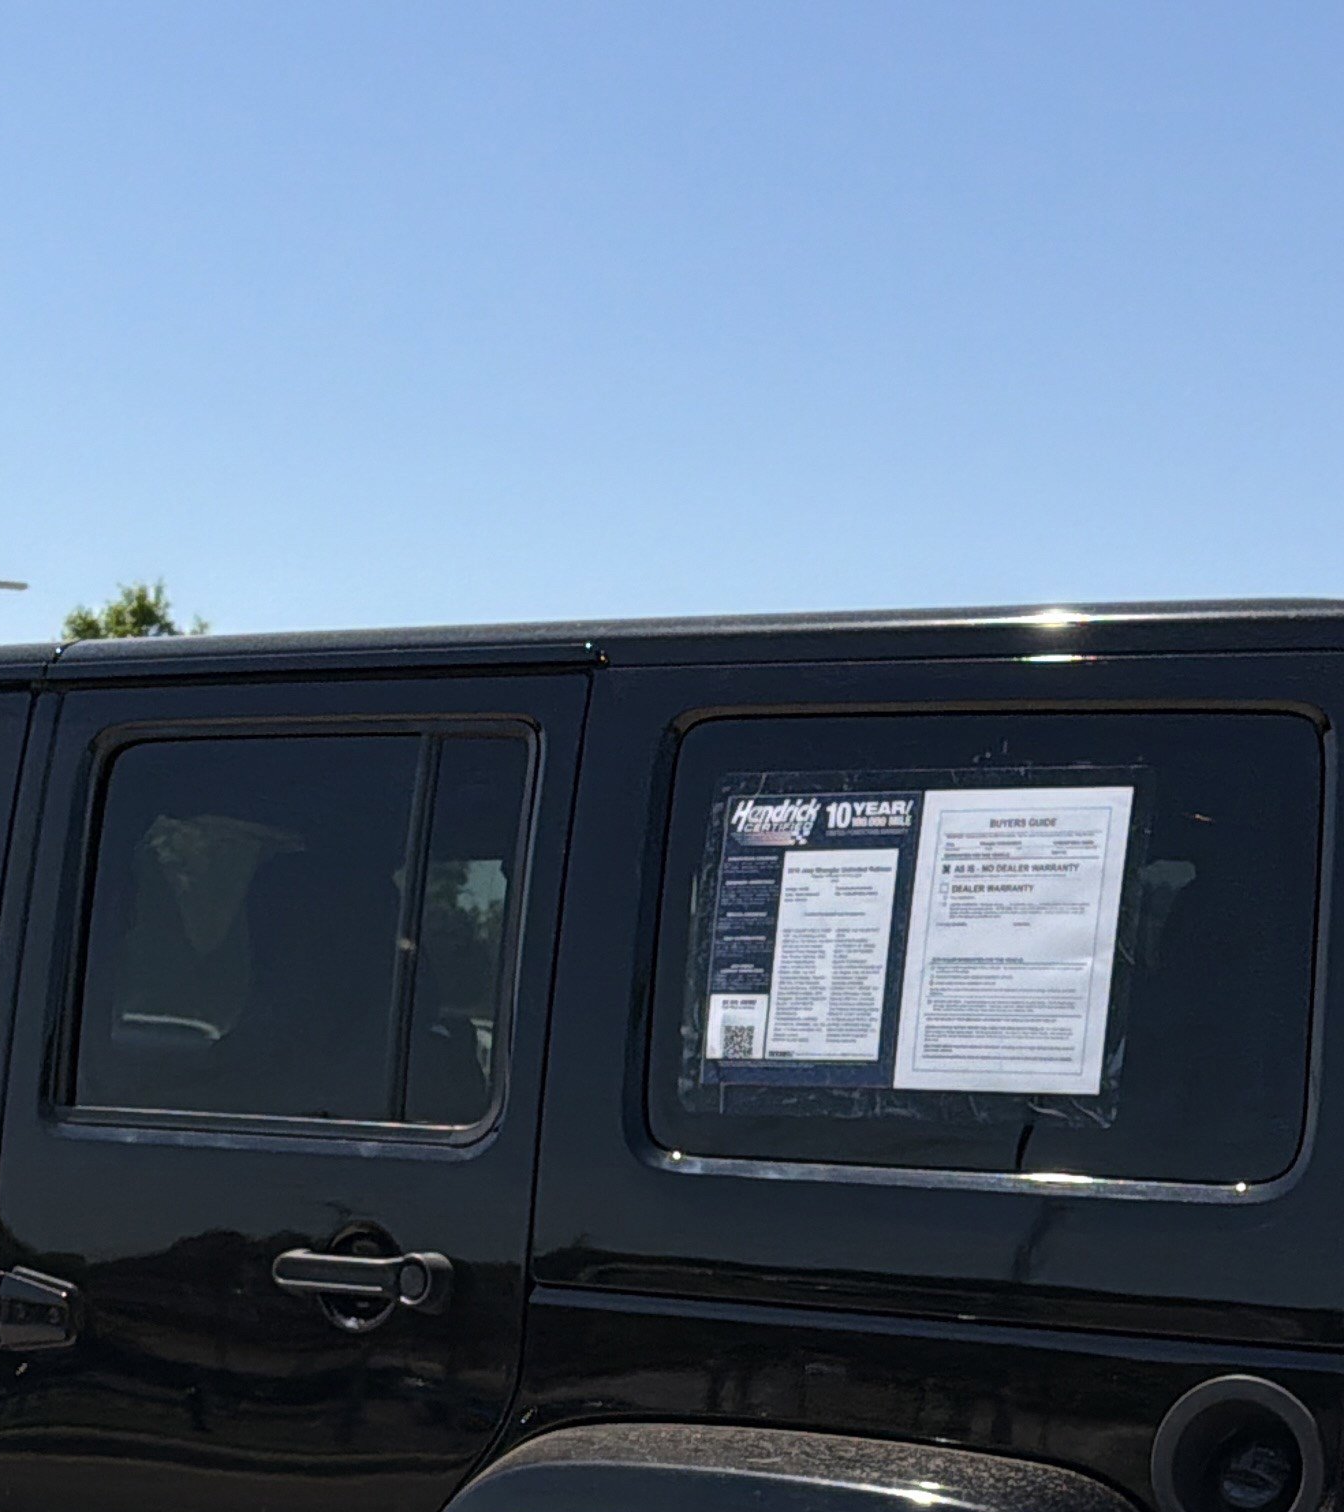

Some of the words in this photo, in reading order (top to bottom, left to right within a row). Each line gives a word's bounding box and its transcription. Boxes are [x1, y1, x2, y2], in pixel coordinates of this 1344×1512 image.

[731, 798, 822, 833] Hendrick
[825, 801, 852, 829] 10
[990, 818, 1027, 828] BUYERS
[1028, 817, 1058, 827] GUIDE
[954, 865, 965, 873] AS
[967, 865, 975, 873] IS
[981, 864, 994, 872] NO
[996, 864, 1030, 872] DEALER
[1032, 863, 1080, 872] WARRANTY
[951, 884, 985, 893] DEALER
[987, 884, 1034, 893] WARRANTY
